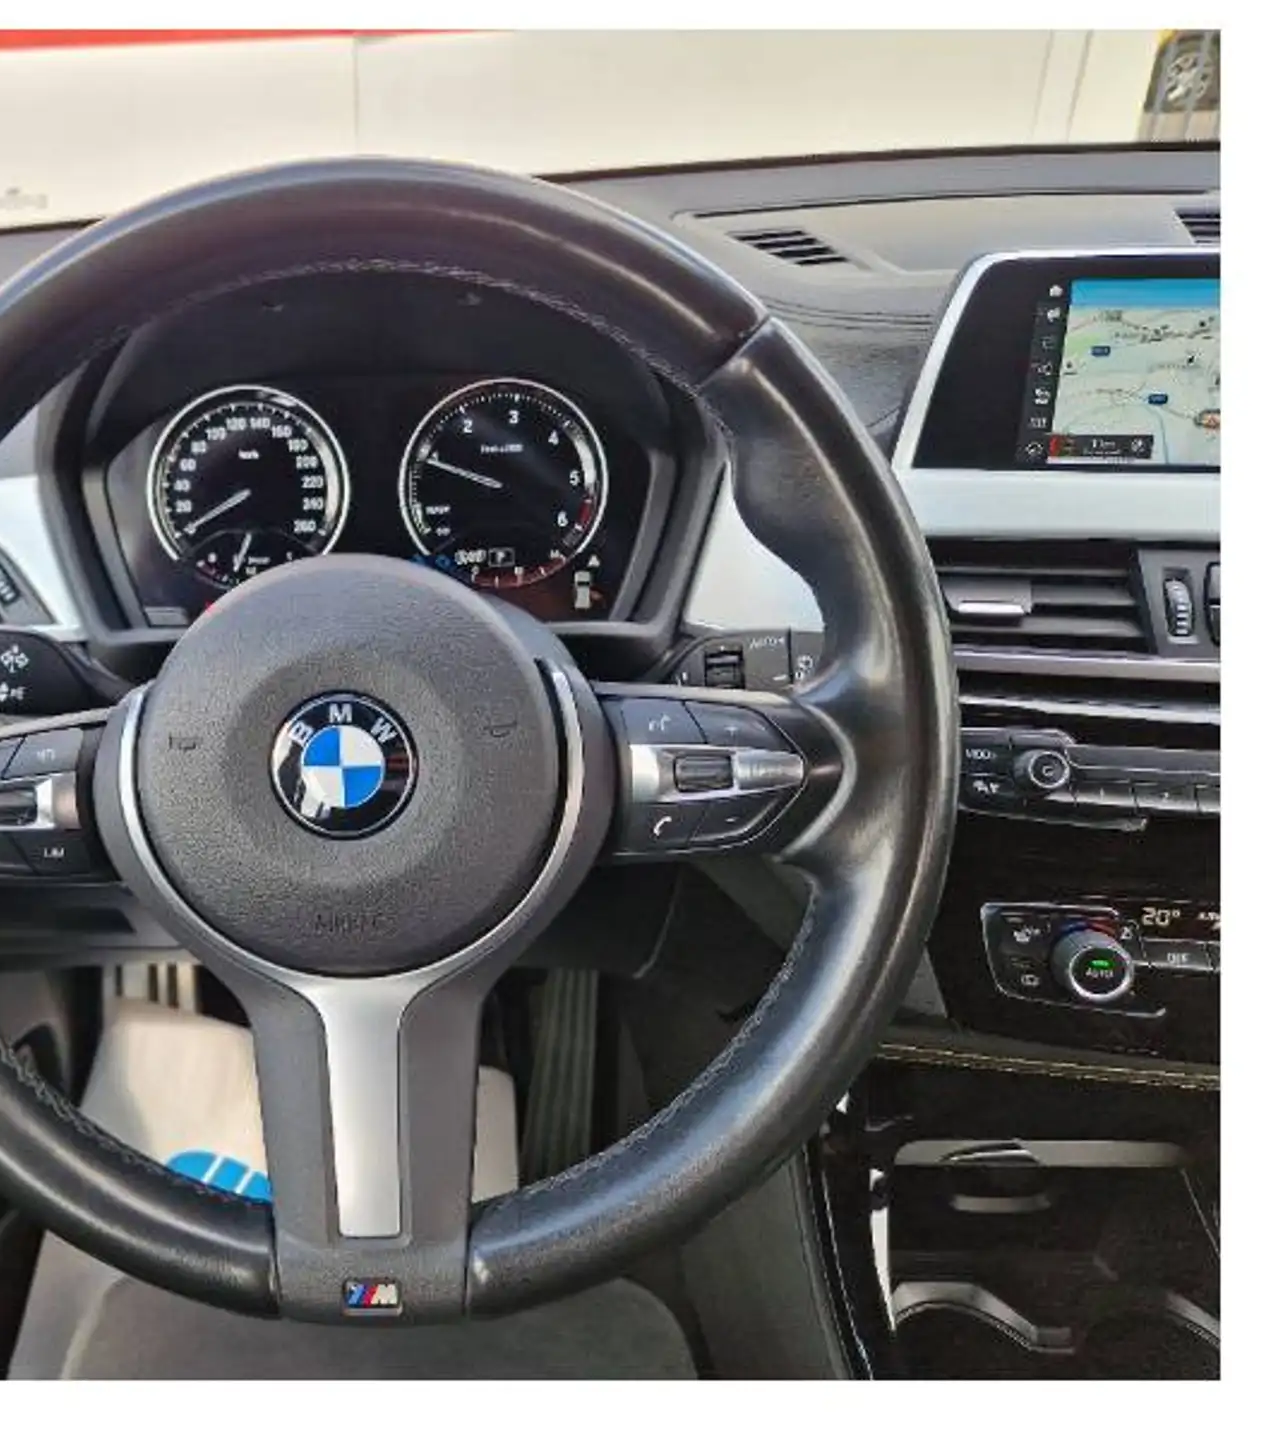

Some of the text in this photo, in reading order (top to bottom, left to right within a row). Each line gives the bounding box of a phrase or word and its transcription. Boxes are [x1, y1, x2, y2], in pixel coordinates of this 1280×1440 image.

[508, 410, 520, 425] 3
[463, 420, 474, 434] 2
[547, 429, 560, 446] 4
[569, 470, 581, 487] 5
[556, 511, 568, 527] 6
